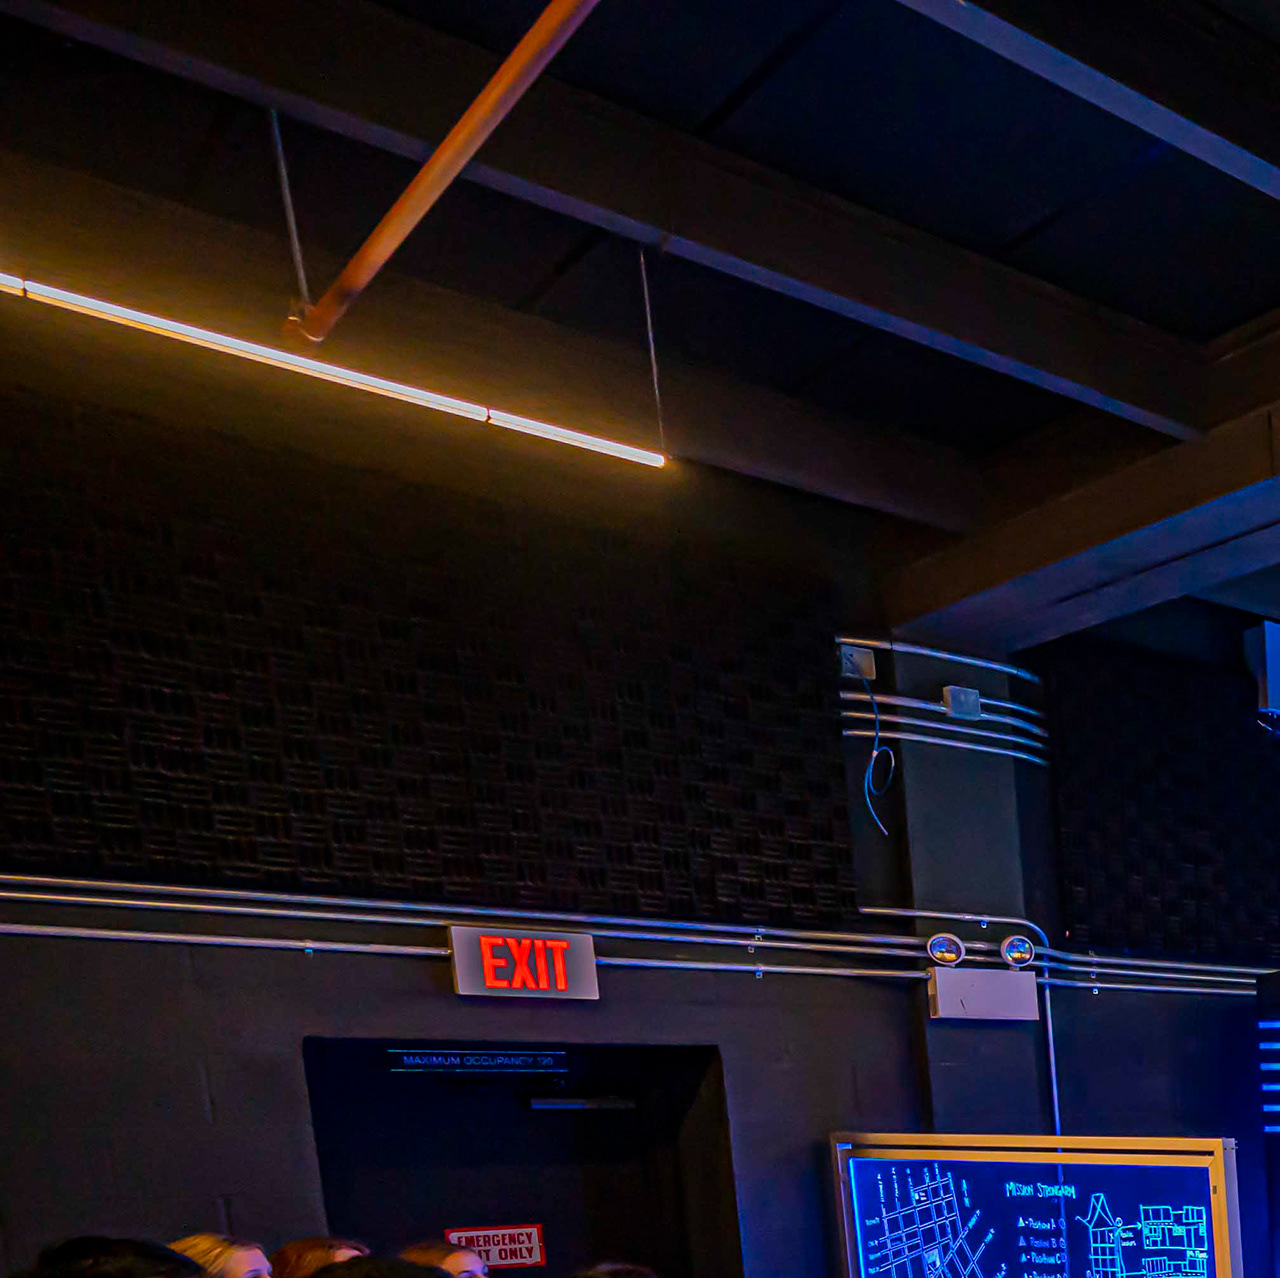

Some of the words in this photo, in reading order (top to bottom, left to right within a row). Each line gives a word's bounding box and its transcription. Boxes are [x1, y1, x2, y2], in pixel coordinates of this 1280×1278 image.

[480, 936, 569, 991] EXIT
[403, 1056, 460, 1065] MAXIMUM
[463, 1056, 533, 1065] OCCUPANCY
[457, 1232, 533, 1247] EMERGENCY
[498, 1246, 533, 1261] ONLY
